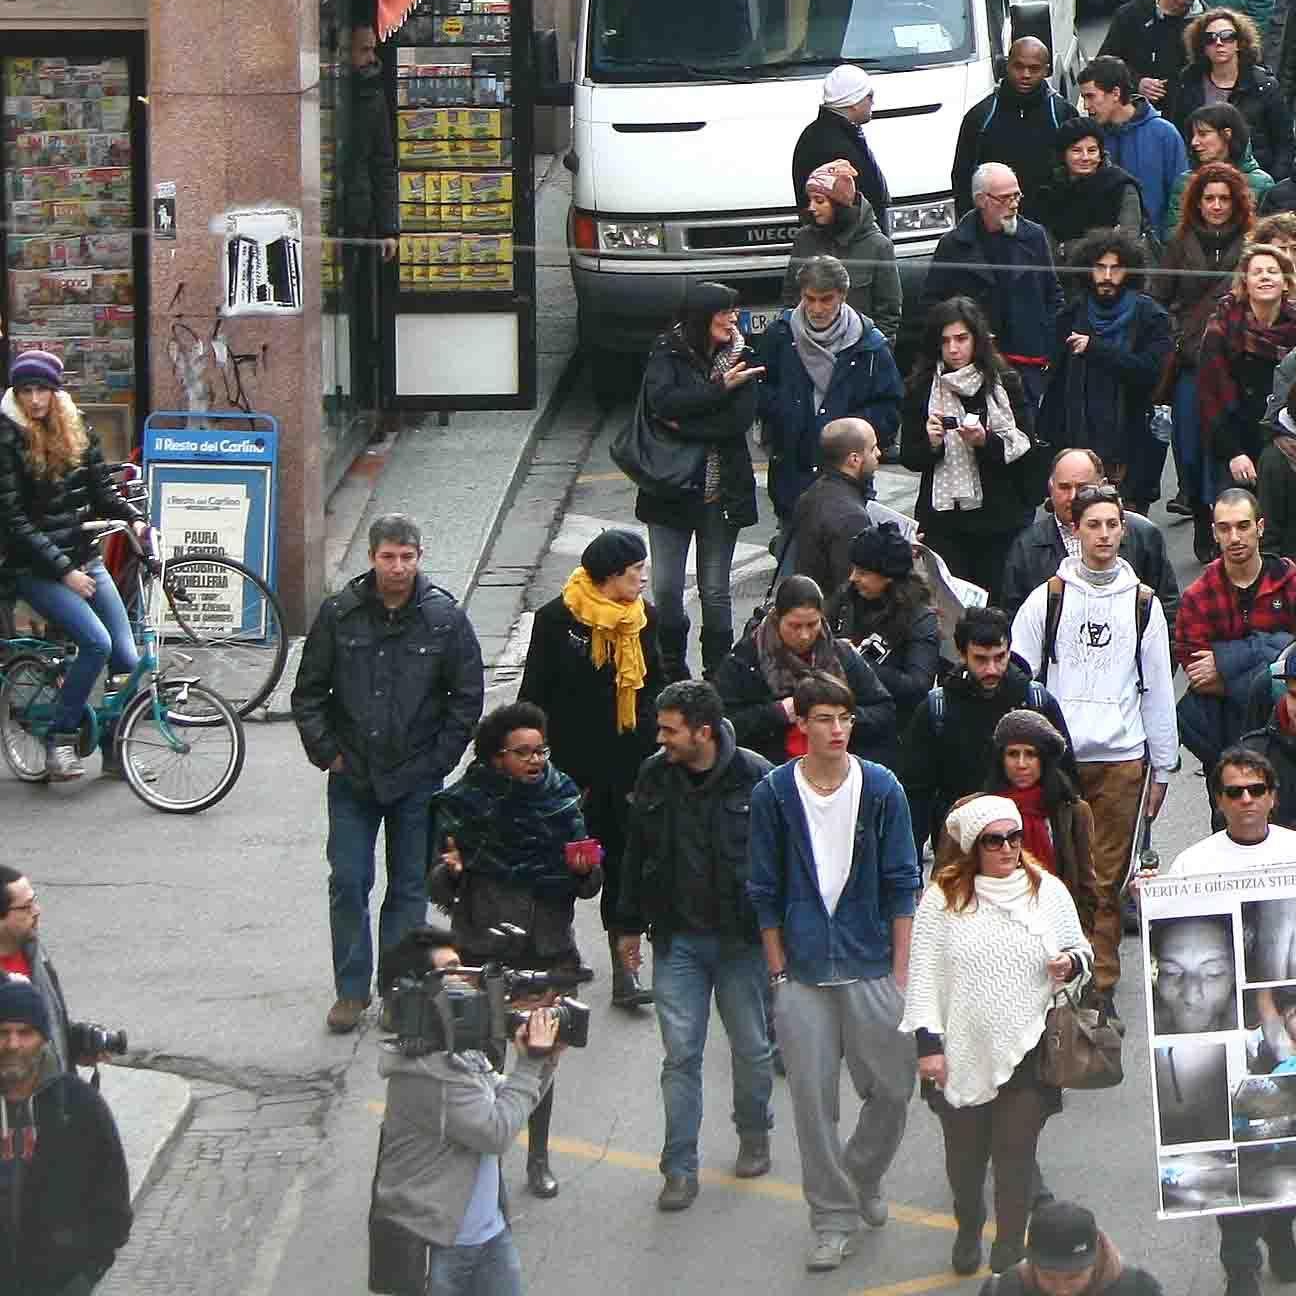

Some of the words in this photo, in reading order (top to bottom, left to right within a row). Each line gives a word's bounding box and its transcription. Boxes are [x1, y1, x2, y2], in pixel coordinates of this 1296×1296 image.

[746, 226, 799, 242] IVECO
[164, 438, 198, 452] Resto
[200, 439, 218, 453] del
[184, 531, 218, 545] PAURA
[1205, 877, 1265, 894] GIUSTIZIA
